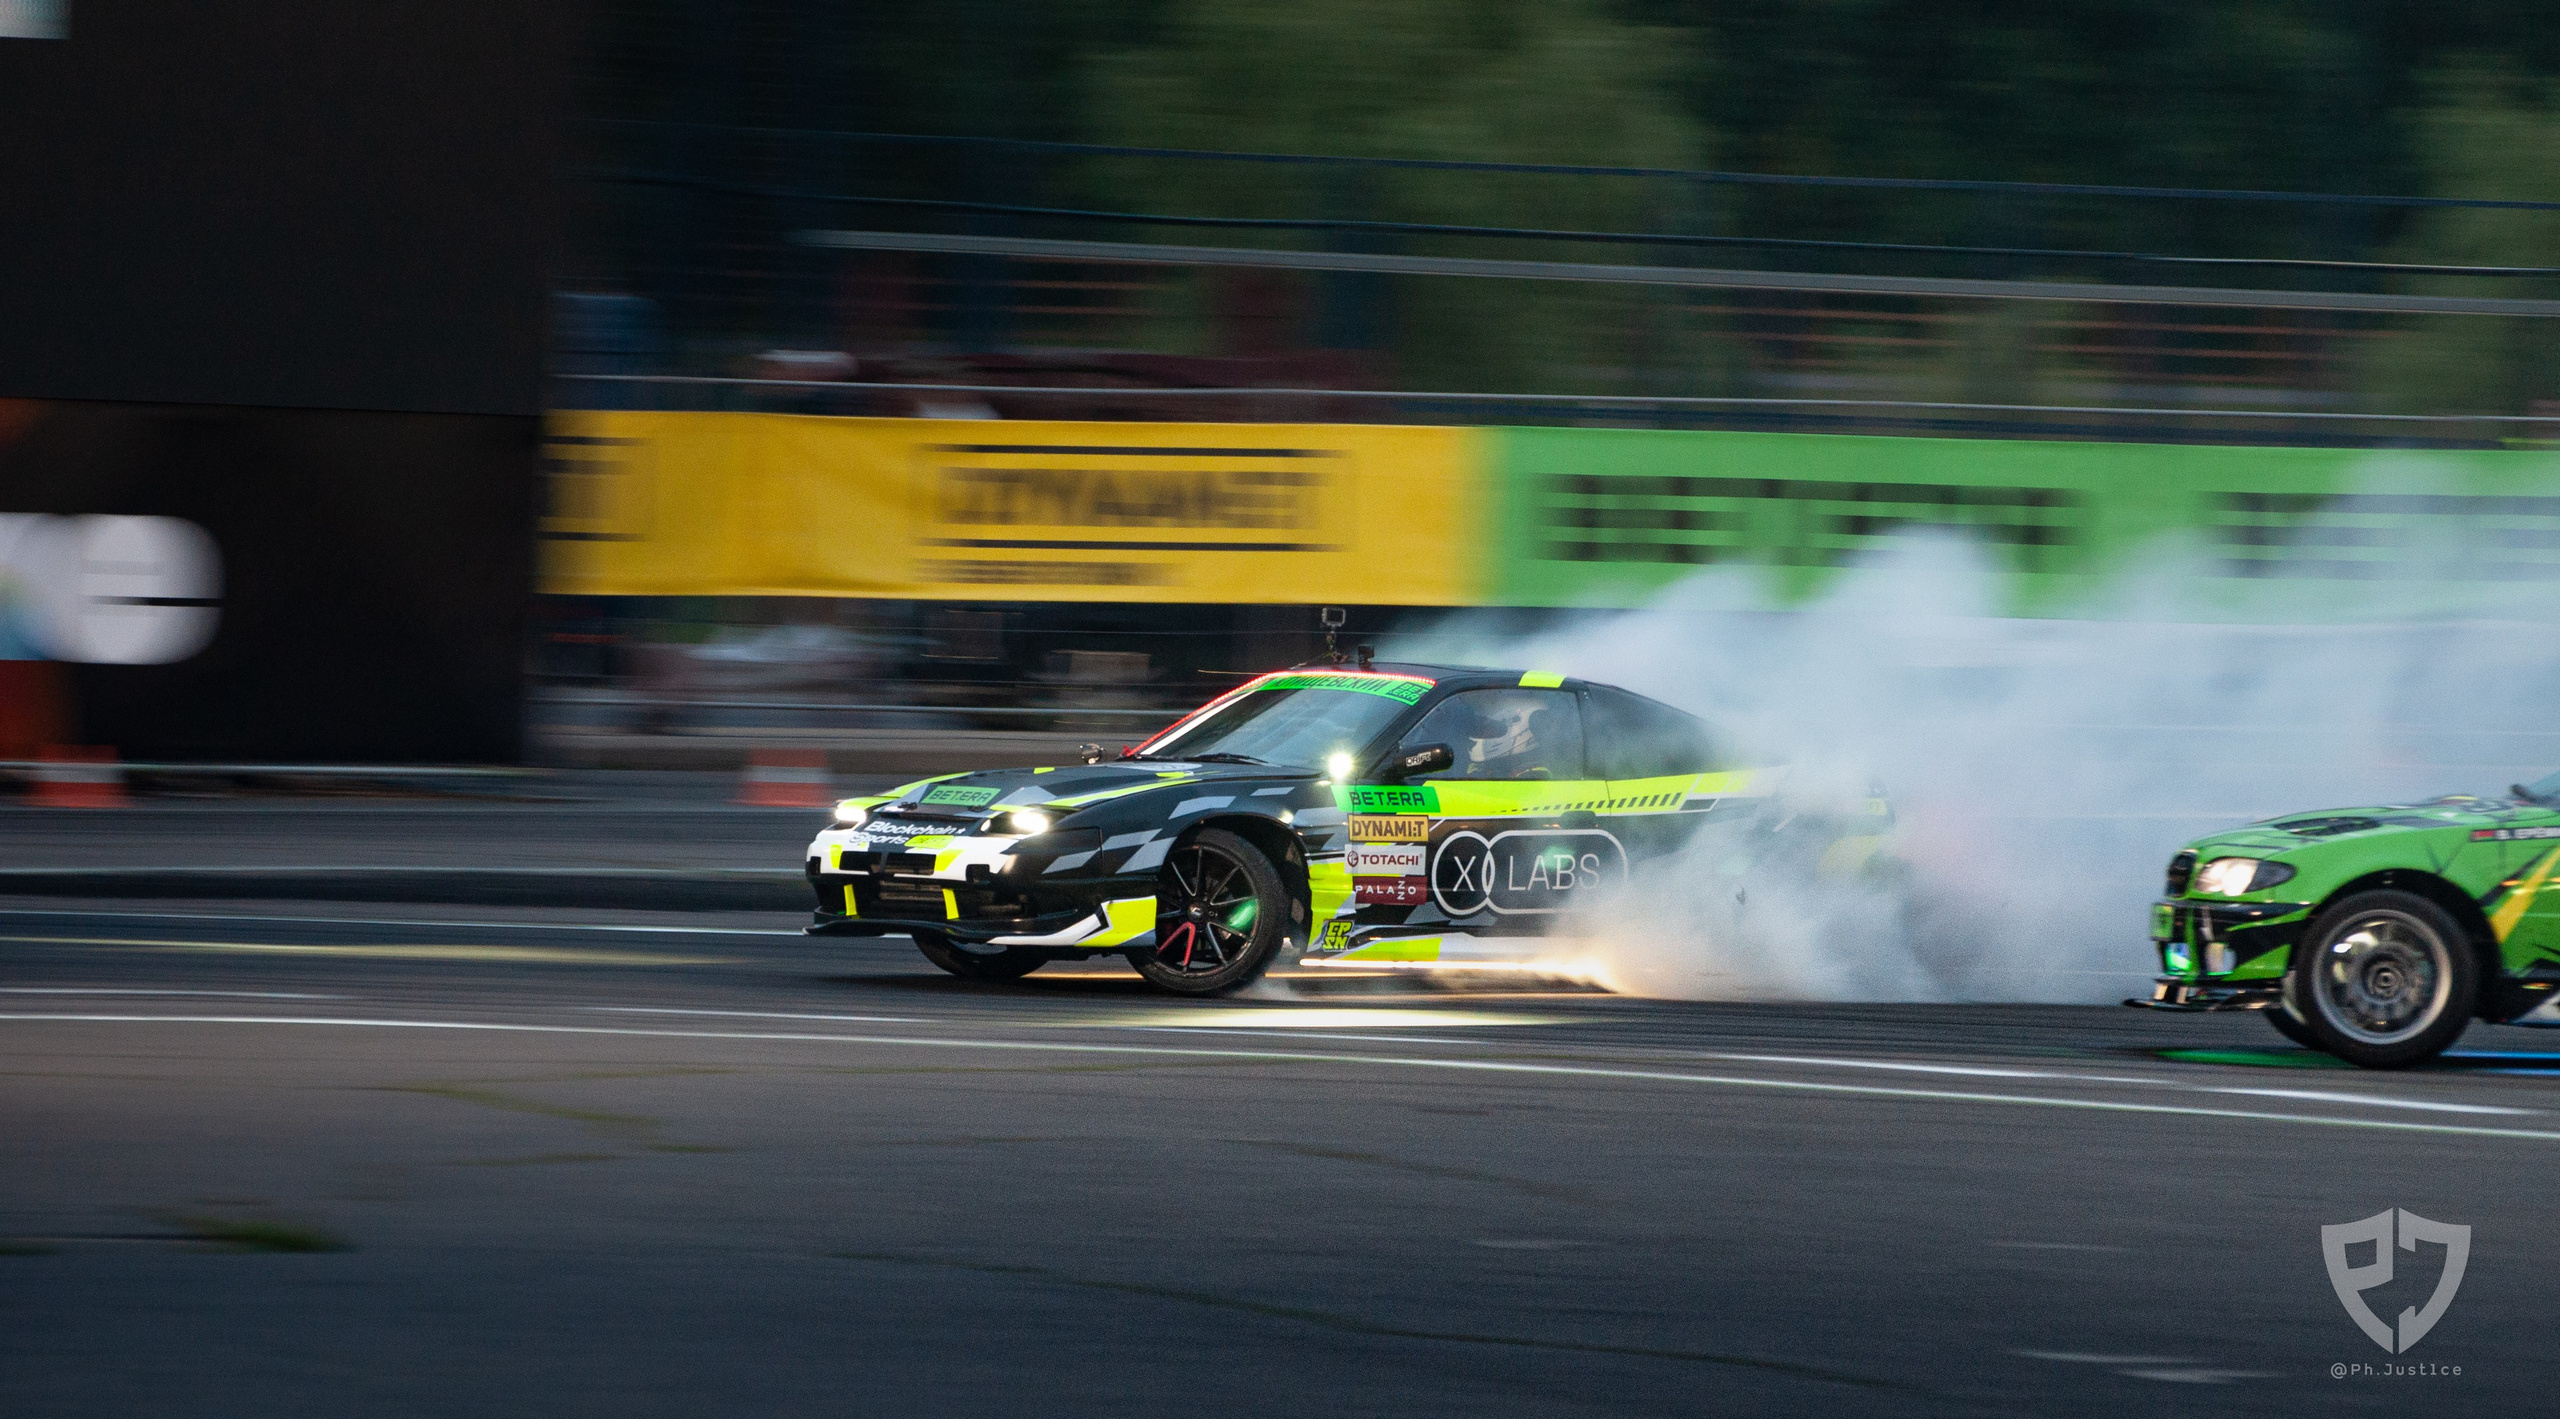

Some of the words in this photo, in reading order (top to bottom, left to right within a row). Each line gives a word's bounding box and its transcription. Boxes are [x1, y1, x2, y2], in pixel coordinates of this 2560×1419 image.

[864, 821, 956, 835] Blockchain
[849, 831, 910, 845] Sports
[1453, 856, 1476, 892] X
[1508, 853, 1600, 891] LABS
